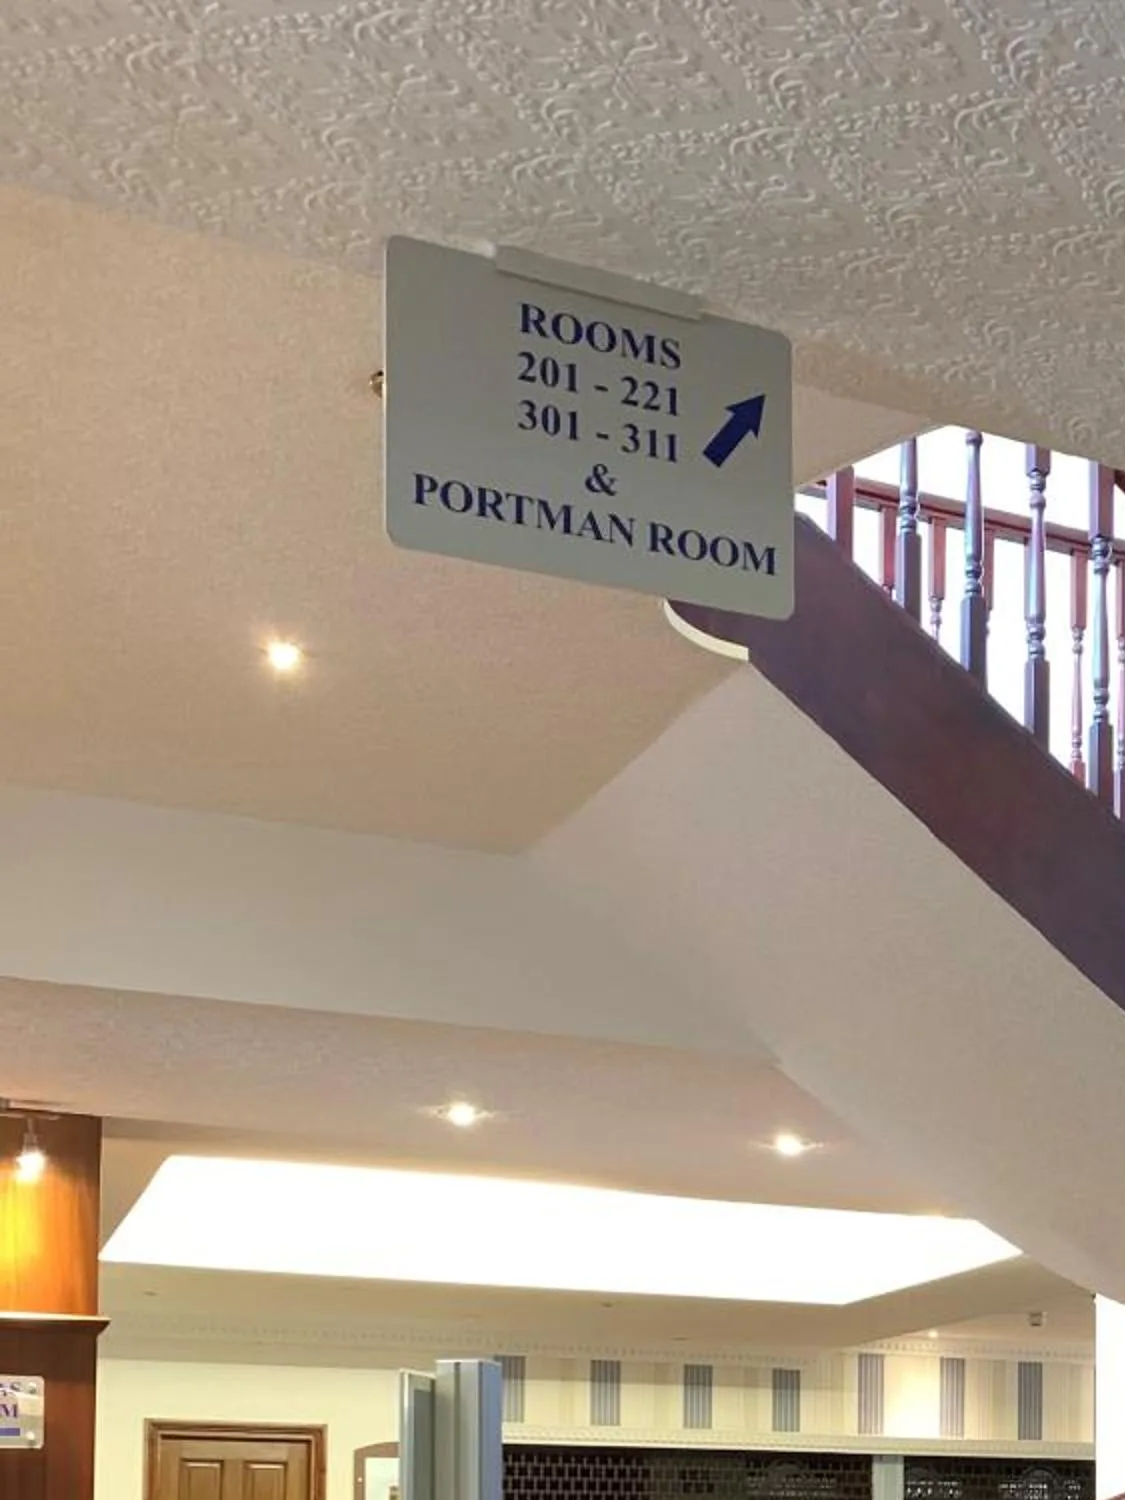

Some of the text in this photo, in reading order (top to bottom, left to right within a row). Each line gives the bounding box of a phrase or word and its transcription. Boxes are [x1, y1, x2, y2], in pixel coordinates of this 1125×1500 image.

[519, 303, 682, 370] ROOMS
[517, 351, 579, 394] 201
[620, 375, 679, 417] 221
[517, 399, 580, 442] 301
[620, 423, 679, 464] 311
[584, 463, 618, 497] &
[413, 472, 777, 577] PORTMAN ROOM
